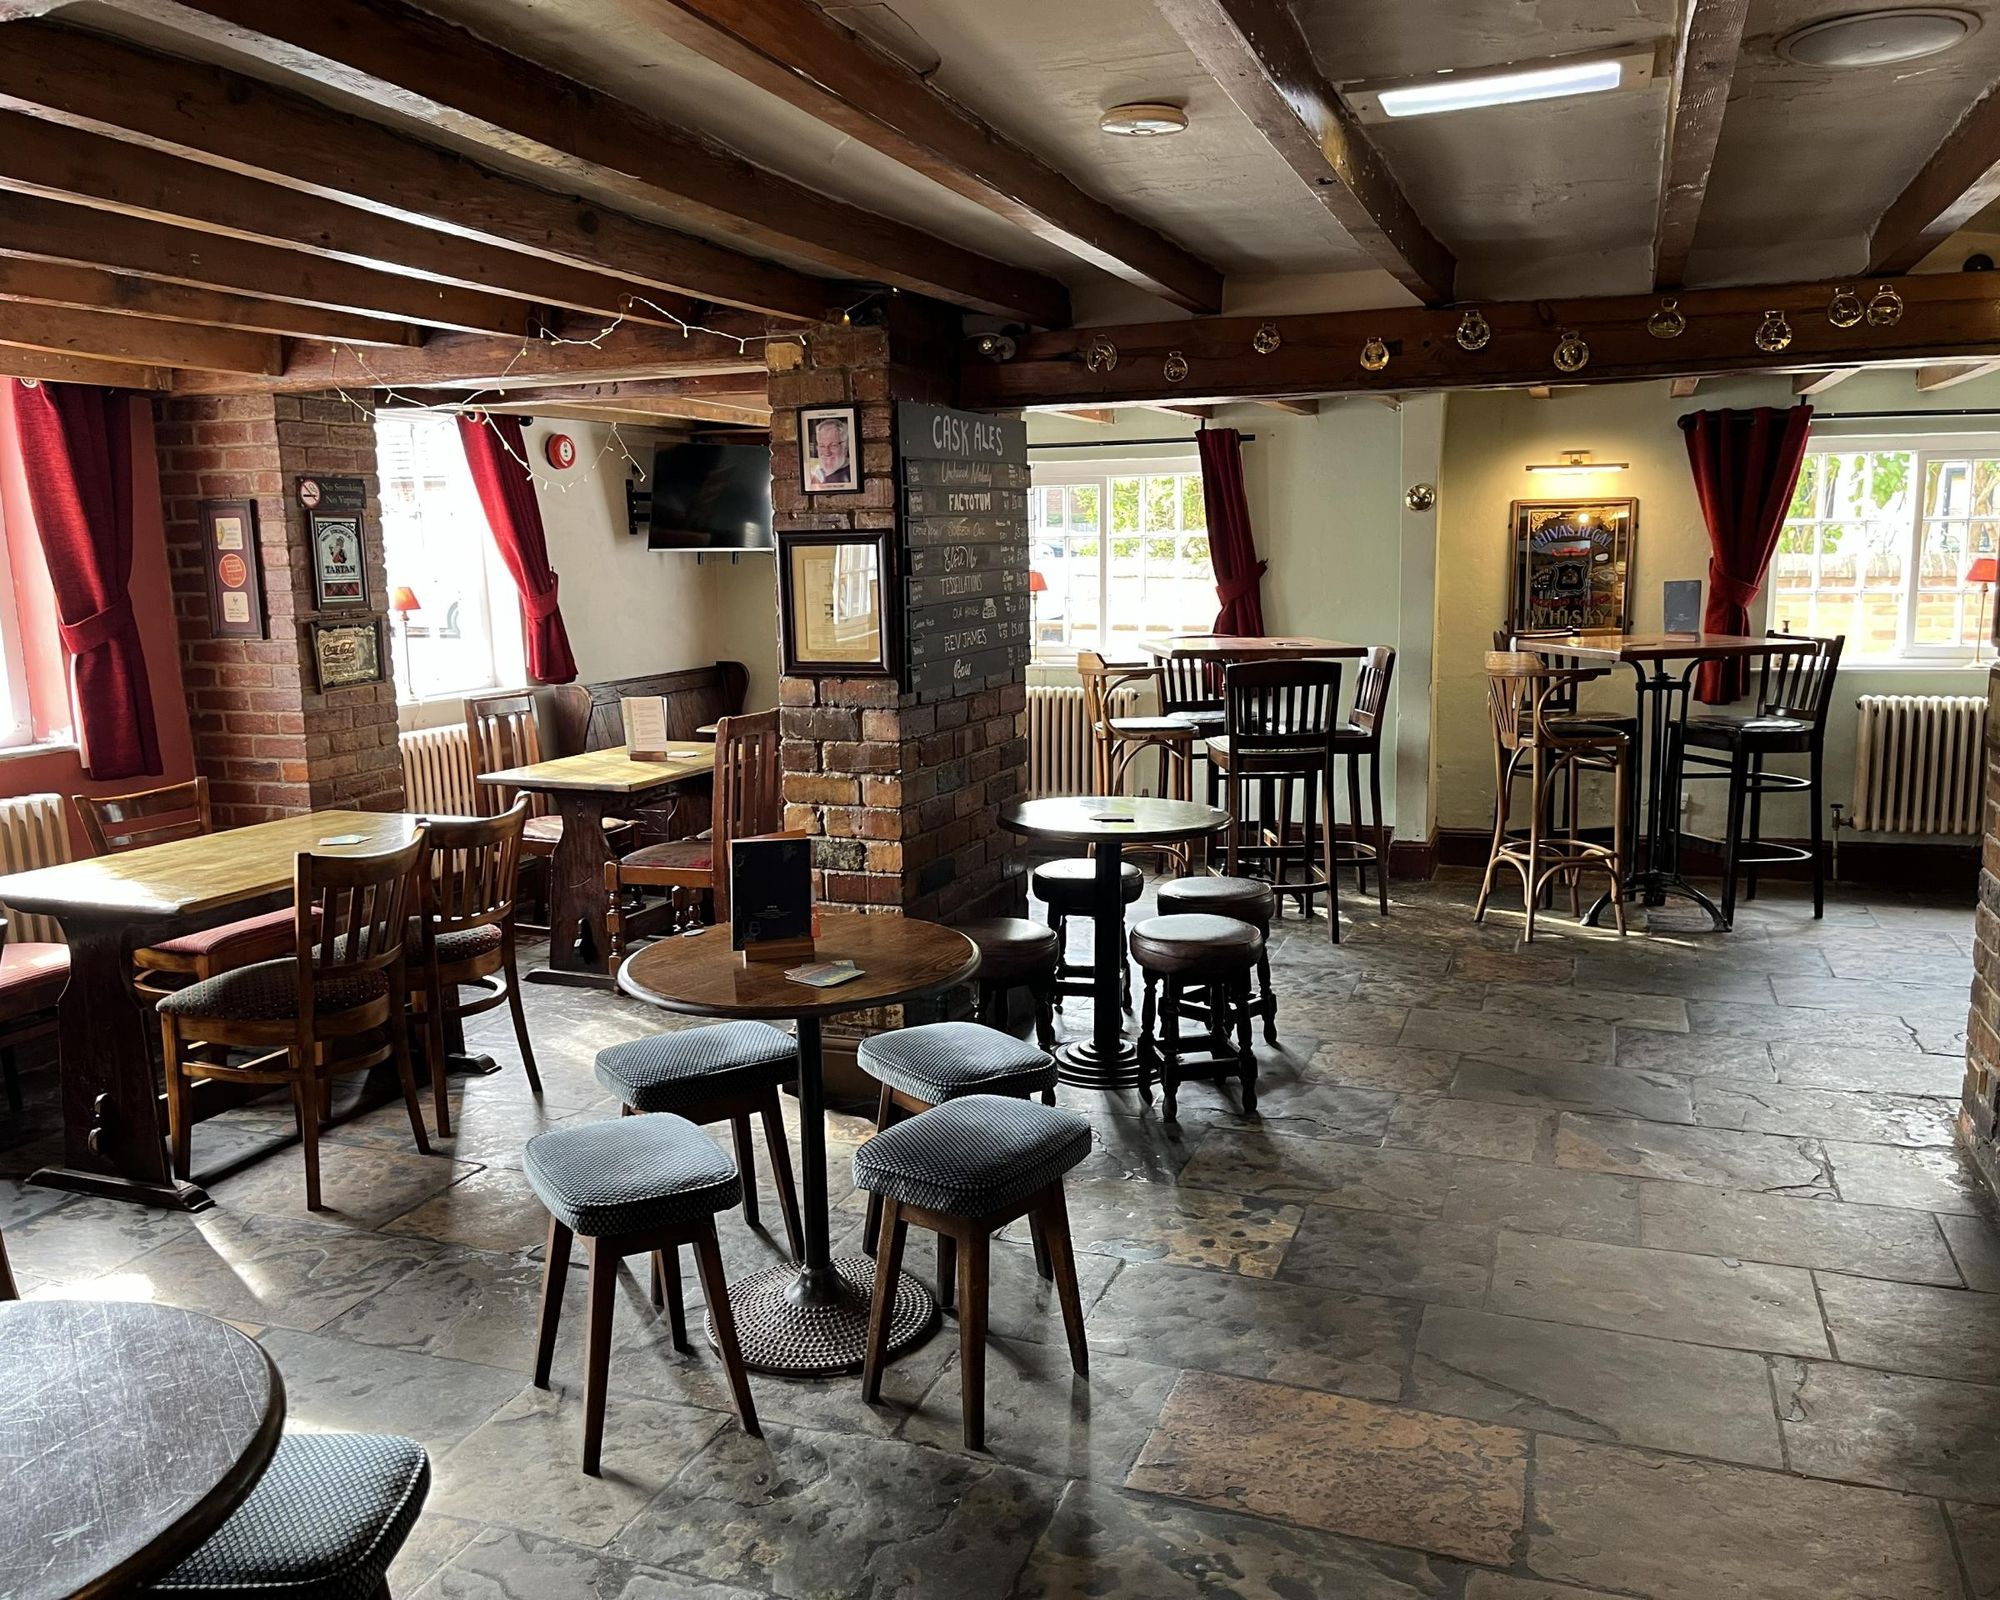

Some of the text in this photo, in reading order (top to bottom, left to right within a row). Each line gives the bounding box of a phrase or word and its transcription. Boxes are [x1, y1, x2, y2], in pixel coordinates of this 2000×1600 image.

[932, 415, 1003, 456] CASK ALES
[948, 491, 992, 512] FACTOTUM
[1576, 525, 1614, 550] REGAL
[325, 564, 357, 575] TARTAN
[1531, 609, 1610, 625] WHISKY
[961, 627, 988, 649] JAMES
